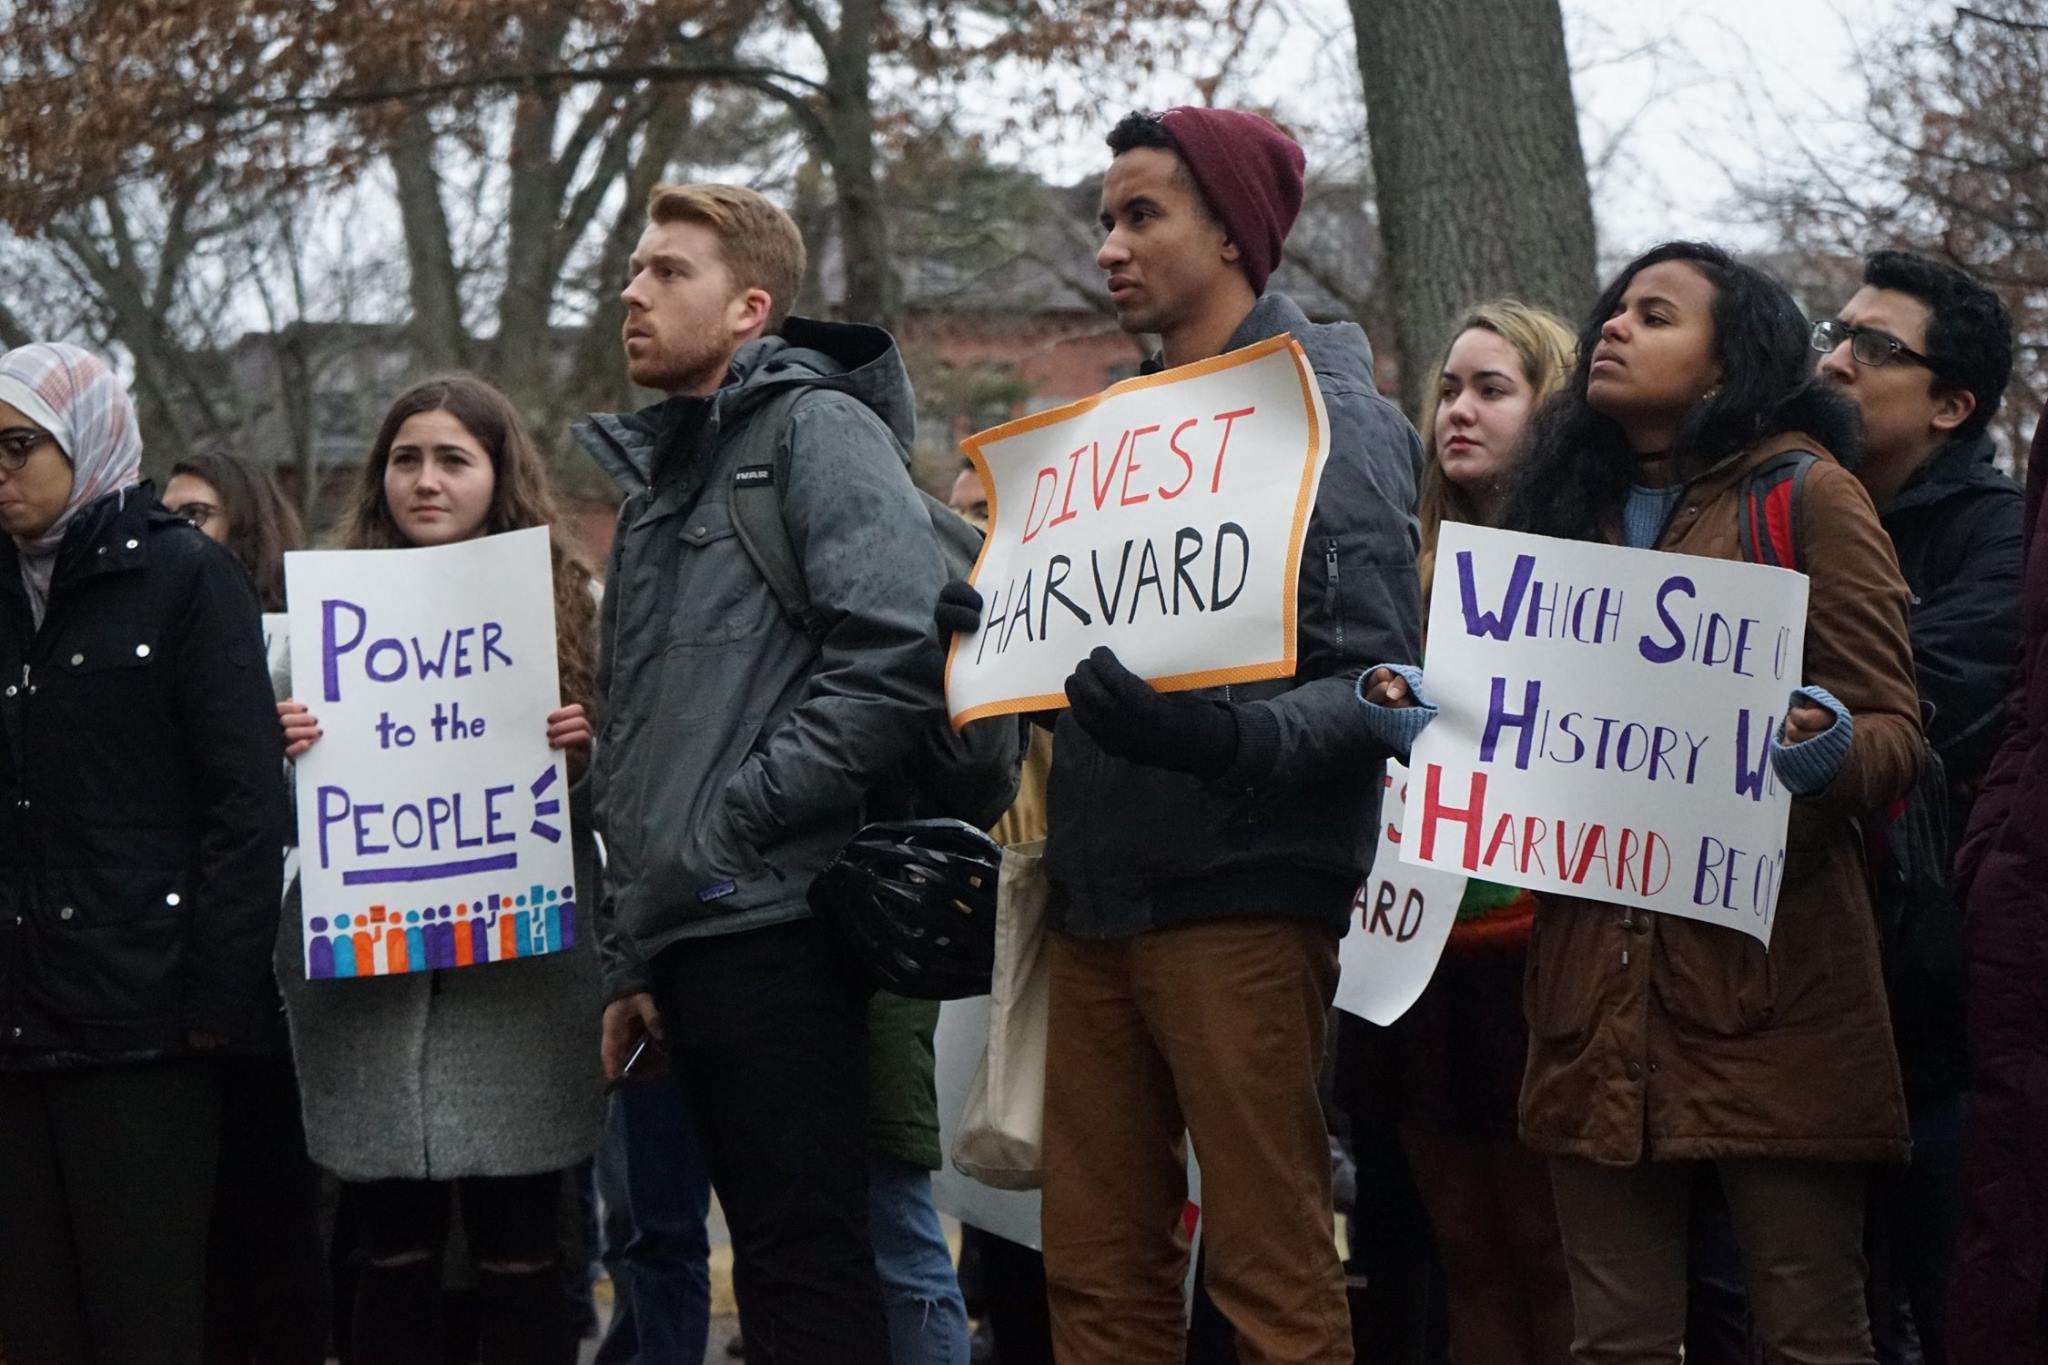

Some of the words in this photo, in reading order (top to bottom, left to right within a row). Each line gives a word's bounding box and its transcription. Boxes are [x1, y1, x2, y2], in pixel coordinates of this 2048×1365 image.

[1022, 406, 1255, 545] DIVEST
[321, 599, 513, 702] POWER
[976, 521, 1250, 665] HARVARD
[1456, 551, 1623, 644] WHICH
[1639, 576, 1760, 677] SIDE
[375, 712, 416, 749] to
[431, 702, 486, 742] the
[1479, 676, 1709, 784] HISTORY
[317, 785, 516, 869] PEOPLE
[1418, 763, 1671, 897] HARVARD
